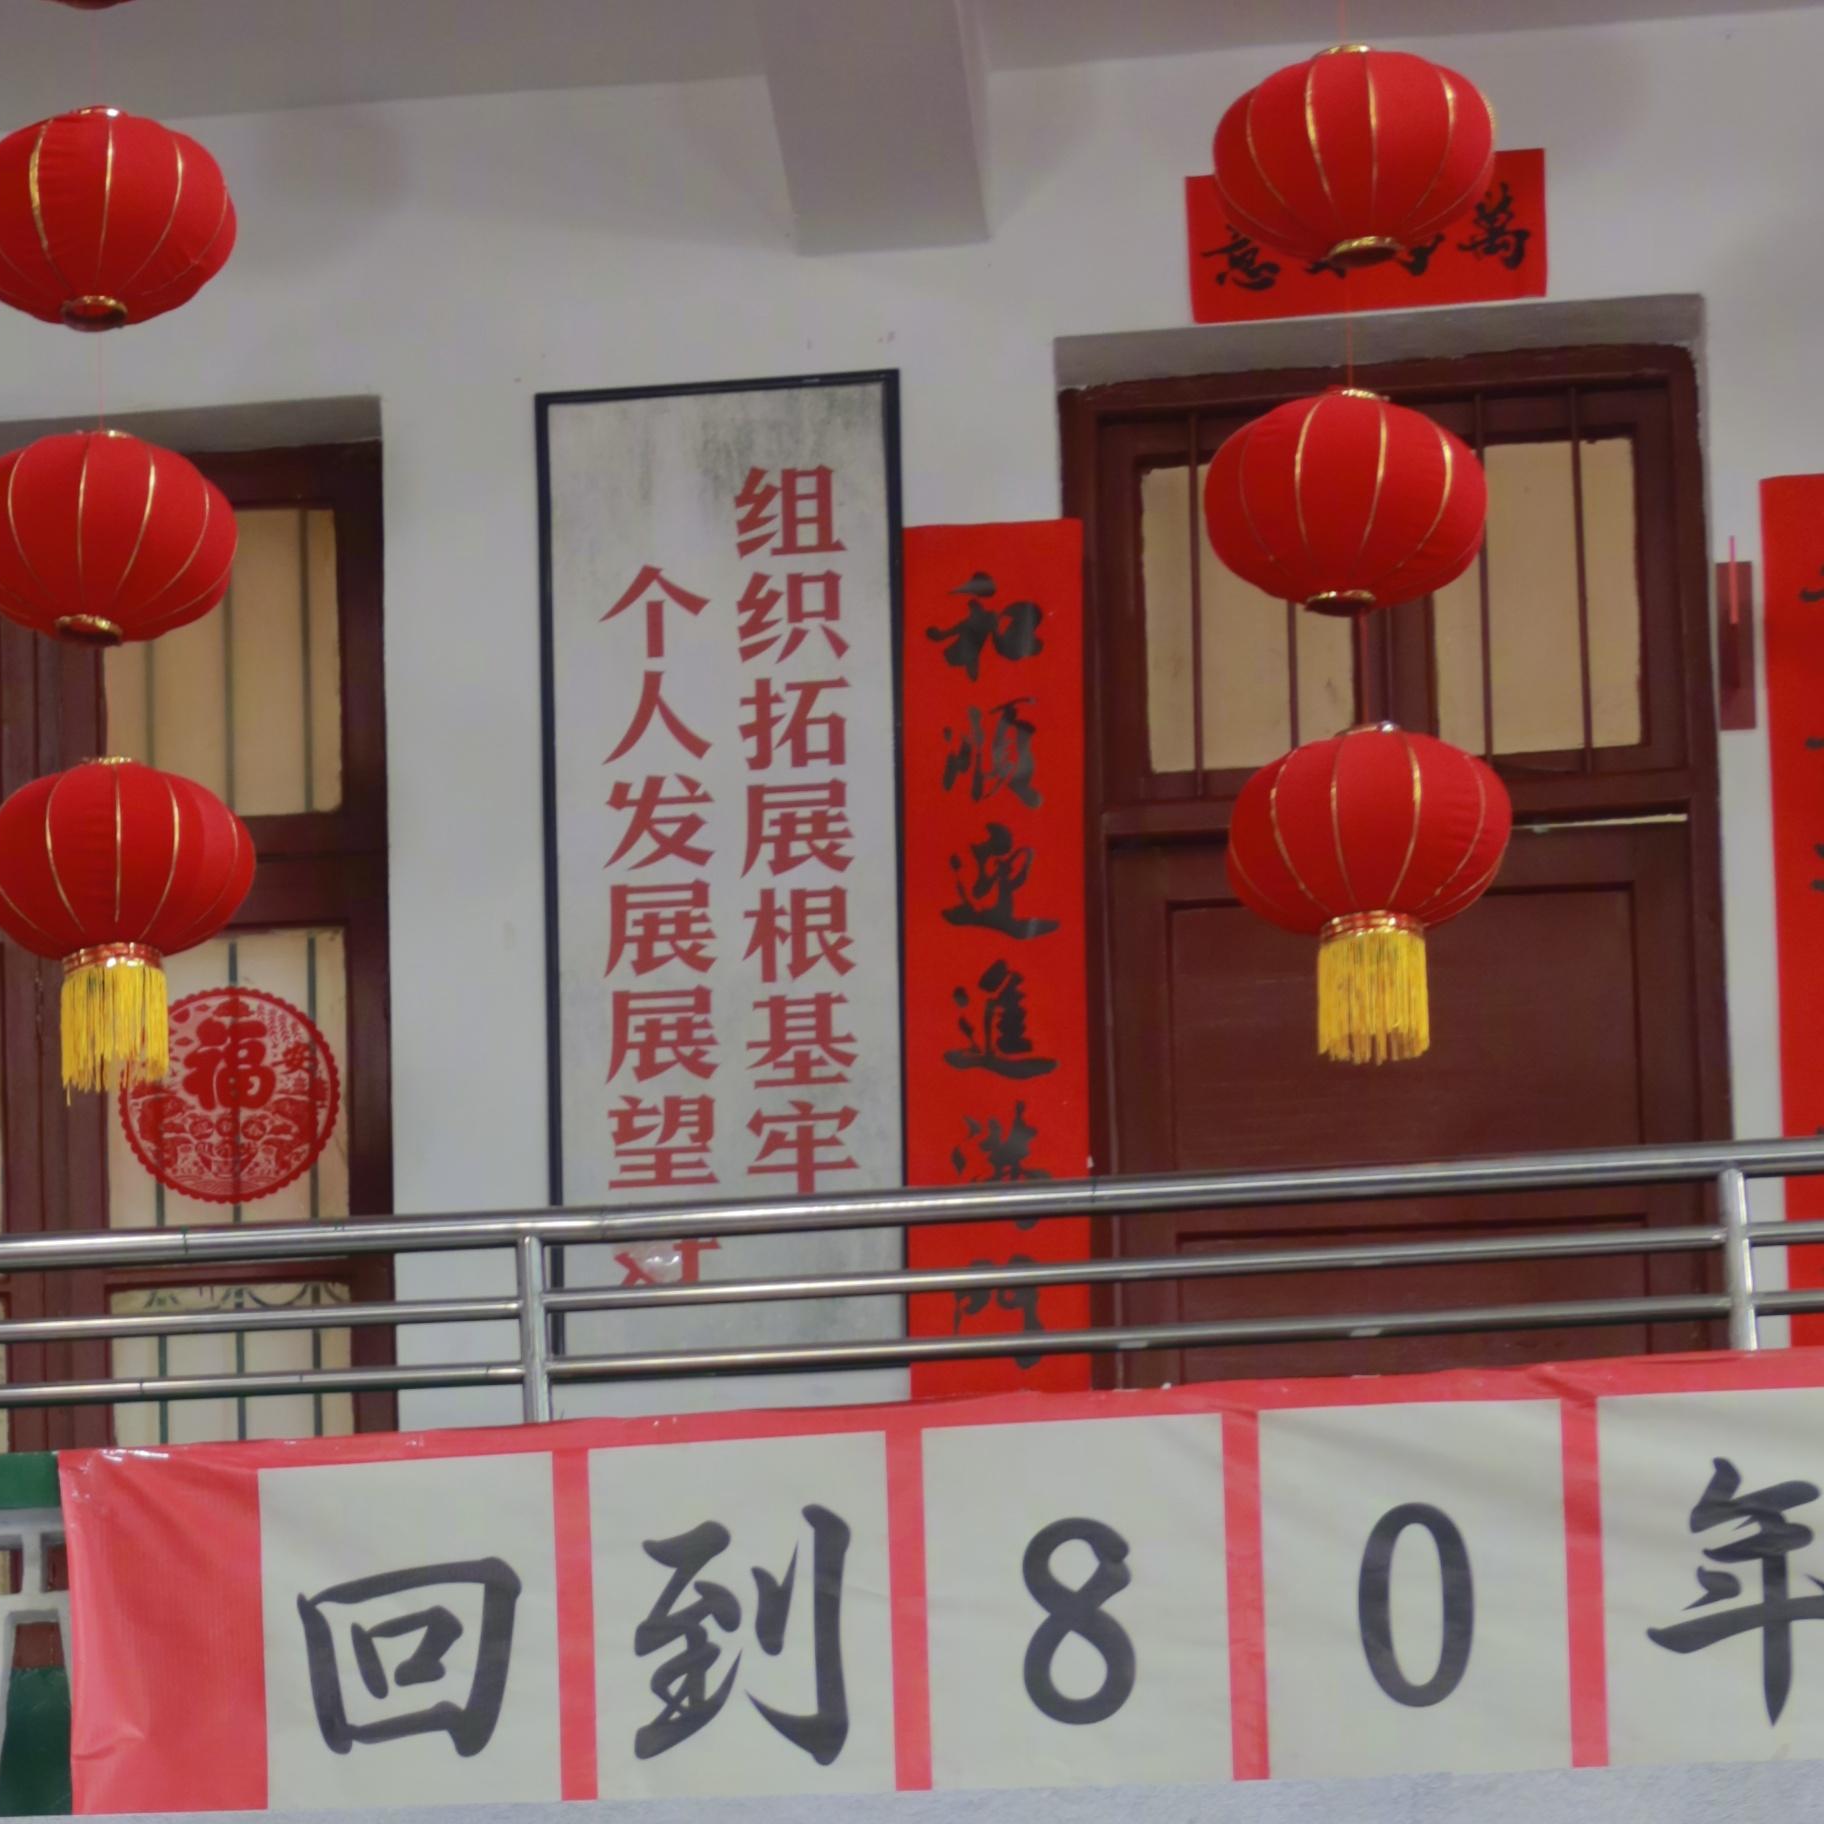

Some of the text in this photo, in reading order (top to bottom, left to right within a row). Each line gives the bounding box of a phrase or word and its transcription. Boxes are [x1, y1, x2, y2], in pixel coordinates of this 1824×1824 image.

[732, 464, 862, 1194] 组织拓展根基牢
